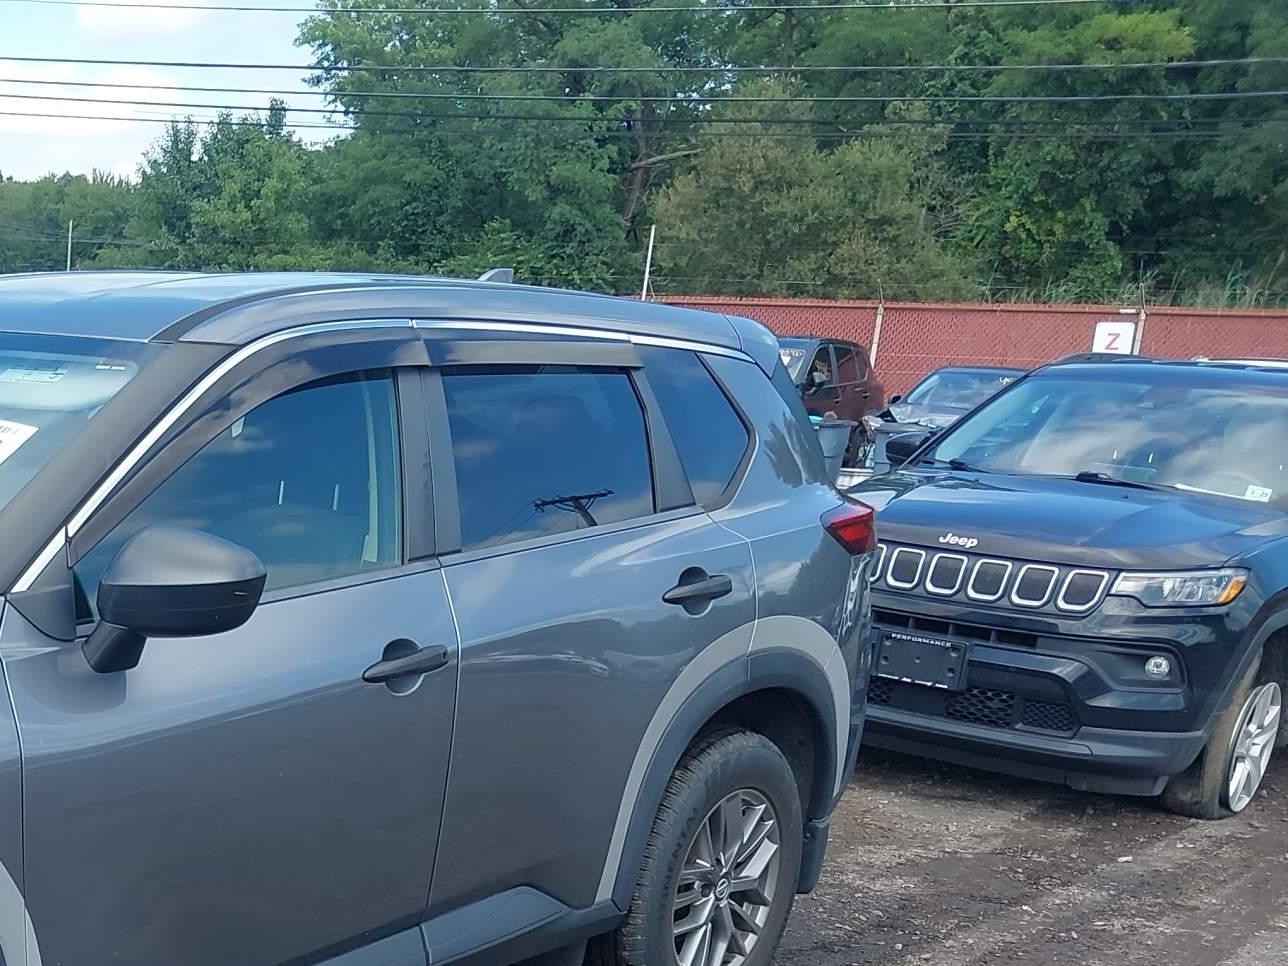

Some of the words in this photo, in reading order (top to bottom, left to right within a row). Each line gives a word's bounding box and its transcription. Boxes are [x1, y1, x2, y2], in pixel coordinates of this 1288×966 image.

[1104, 332, 1121, 351] Z
[939, 533, 978, 549] Jeep
[891, 633, 952, 648] PERFORMANCE
